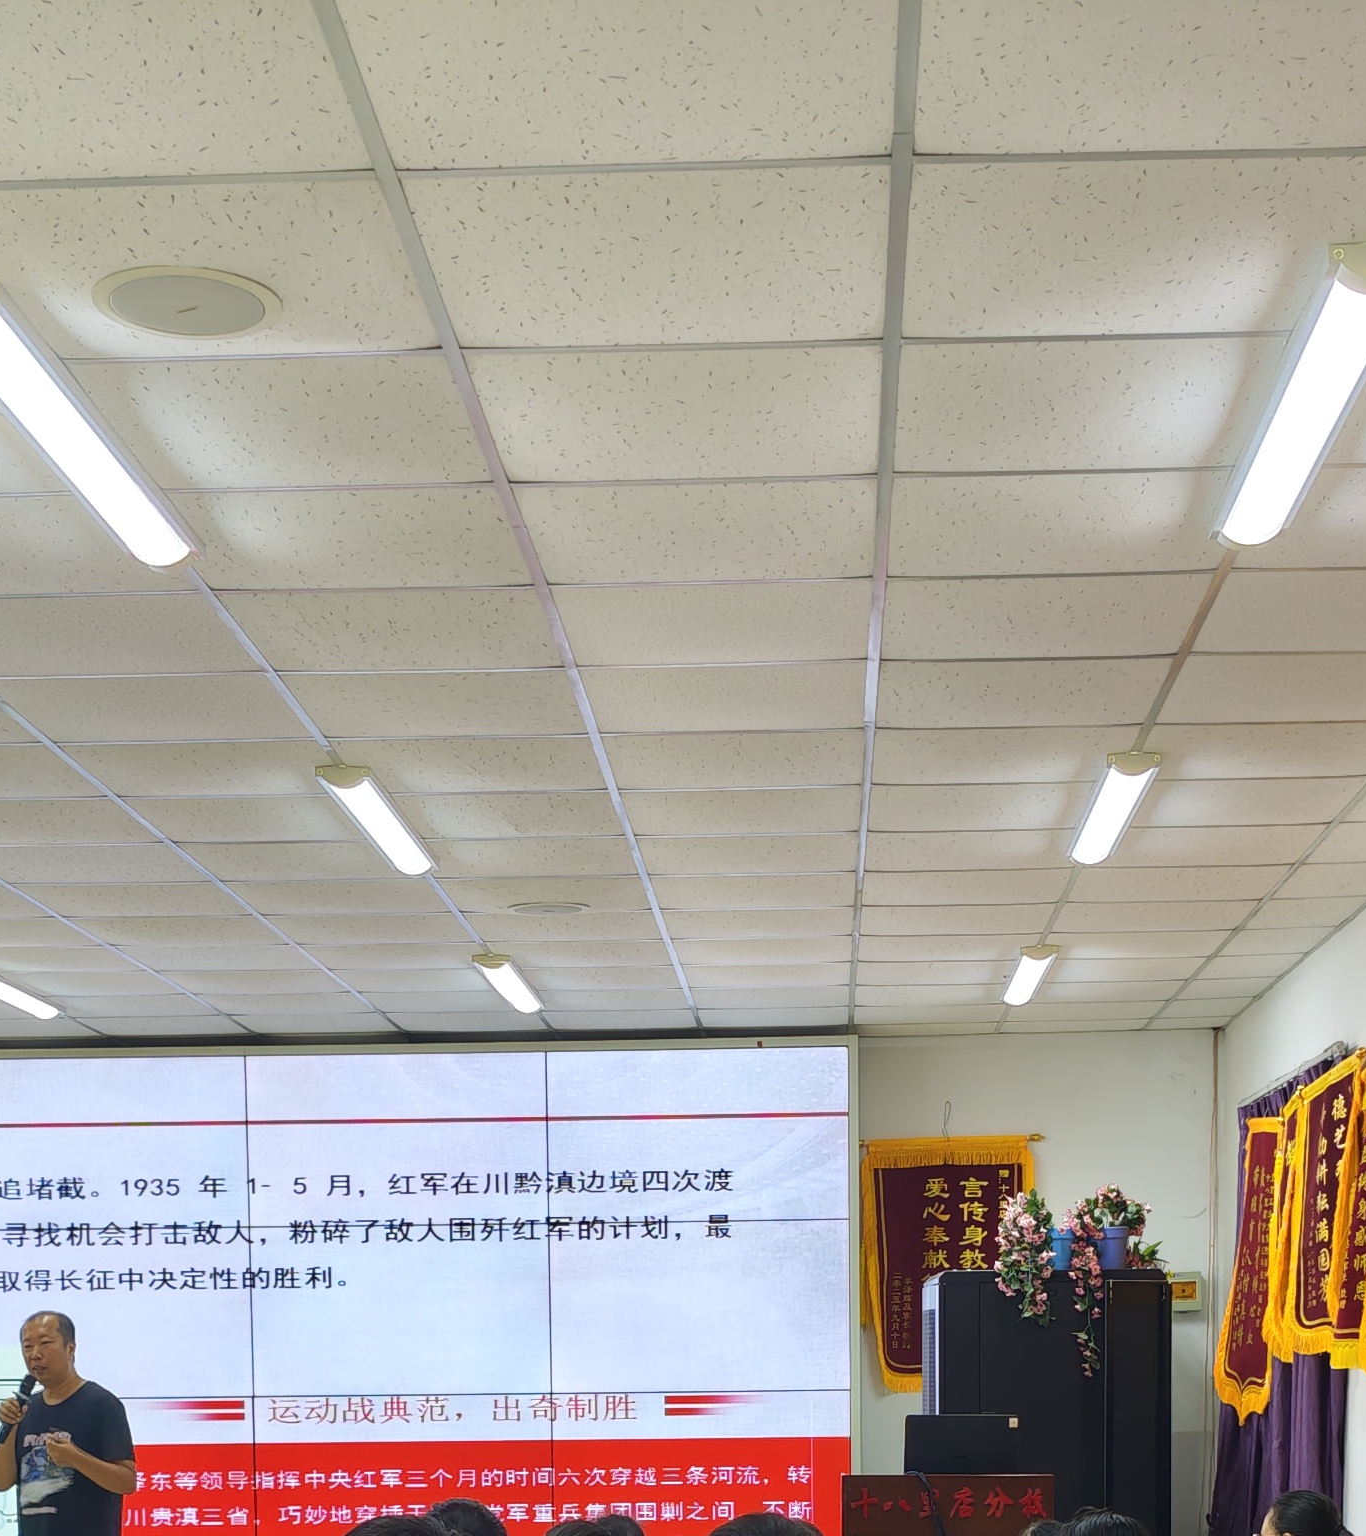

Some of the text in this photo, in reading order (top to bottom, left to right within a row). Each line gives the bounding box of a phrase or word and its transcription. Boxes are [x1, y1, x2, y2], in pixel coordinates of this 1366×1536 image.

[921, 1177, 951, 1282] 爱心奉献
[958, 1177, 989, 1269] 言传身教
[268, 1394, 638, 1425] 运动战典范，出奇制胜
